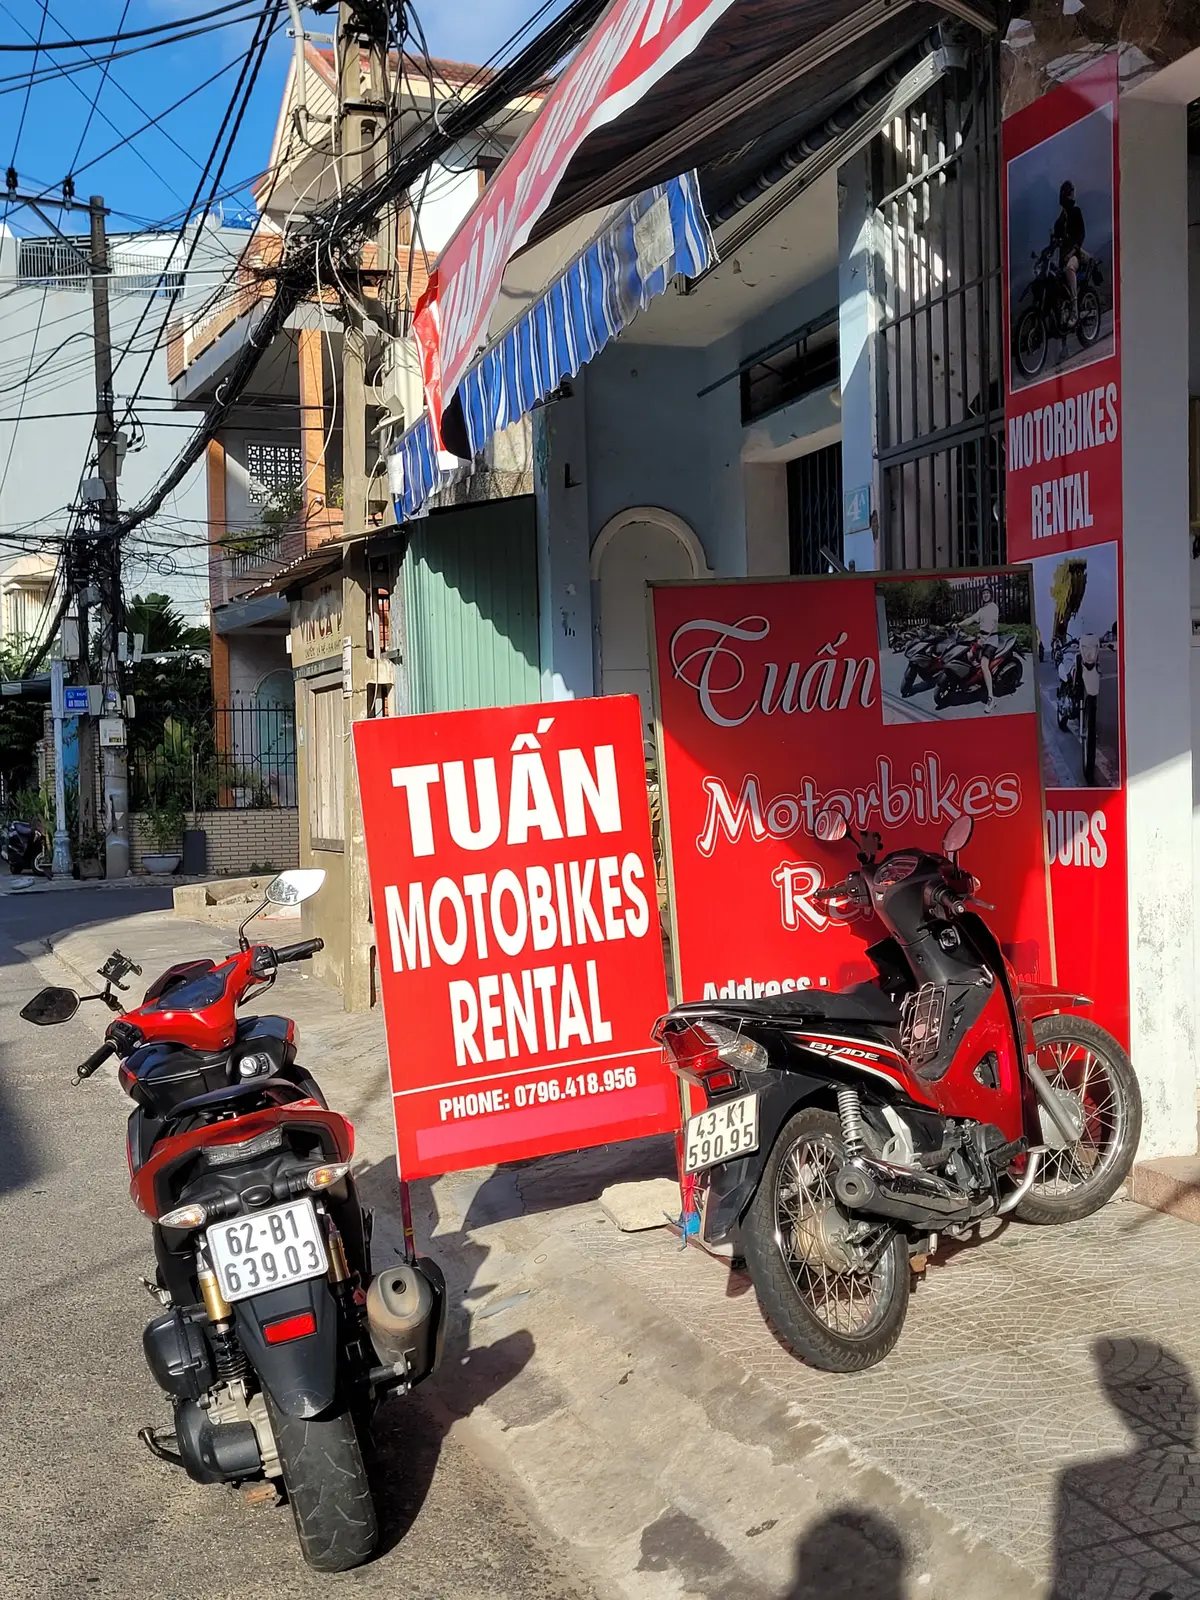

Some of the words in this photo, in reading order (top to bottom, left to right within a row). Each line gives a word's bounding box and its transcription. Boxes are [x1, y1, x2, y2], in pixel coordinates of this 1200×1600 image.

[1008, 382, 1118, 472] MOTORBIKES
[1031, 470, 1094, 540] RENTAL
[670, 615, 876, 727] Tuấn
[391, 717, 622, 857] TUẤN
[697, 752, 1022, 856] Motorbikes
[1046, 809, 1108, 868] OURS
[384, 852, 649, 973] MOTOBIKES
[448, 959, 613, 1067] RENTAL
[809, 1041, 880, 1061] BLADE
[439, 1088, 510, 1122] PHONE:
[514, 1066, 637, 1108] 0796.418.956
[696, 1100, 745, 1139] 43-K1
[688, 1122, 754, 1168] 590.95
[225, 1209, 300, 1257] 62-B1
[224, 1240, 320, 1293] 639.03
